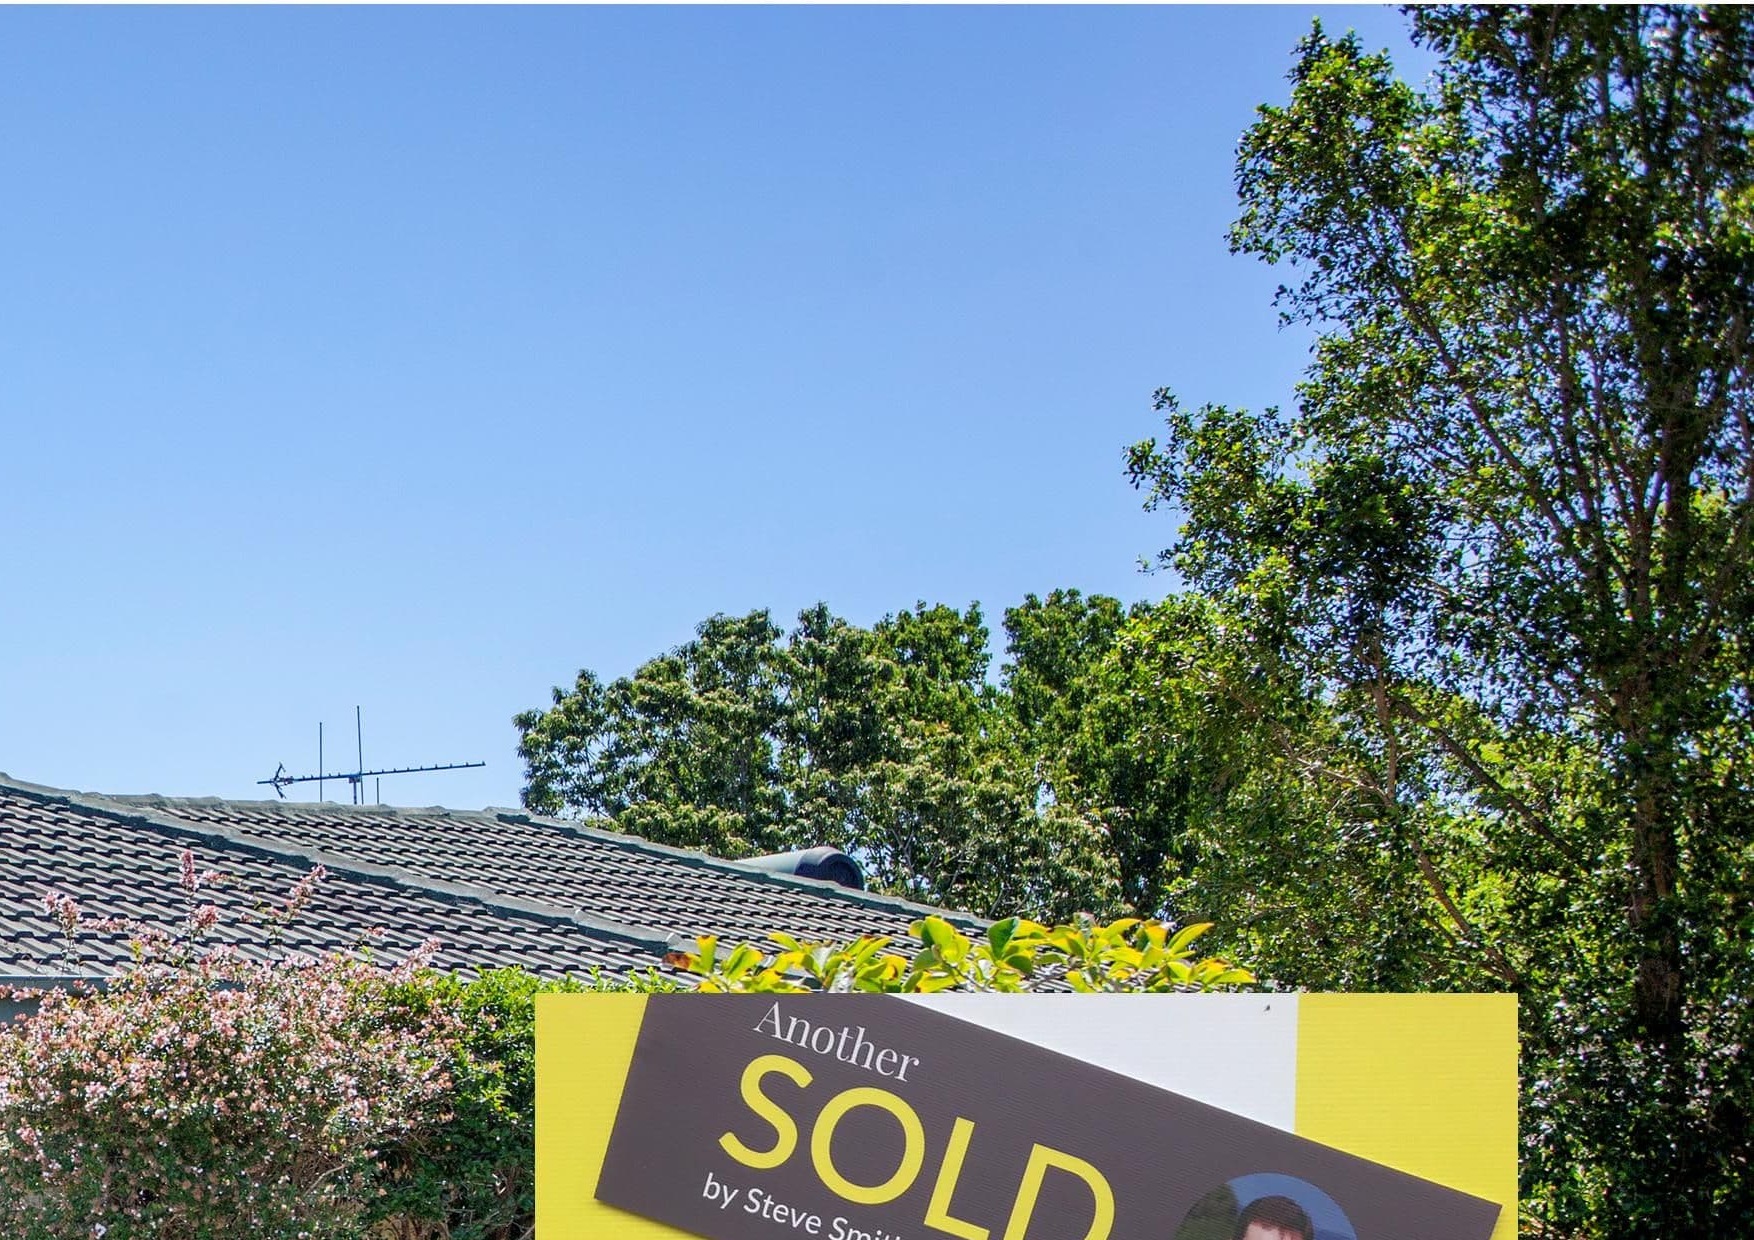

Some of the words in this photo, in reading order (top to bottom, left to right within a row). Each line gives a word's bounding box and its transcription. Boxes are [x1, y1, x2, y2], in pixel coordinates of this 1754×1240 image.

[753, 1001, 920, 1083] Another
[702, 1172, 739, 1210] by
[743, 1187, 822, 1236] Steve
